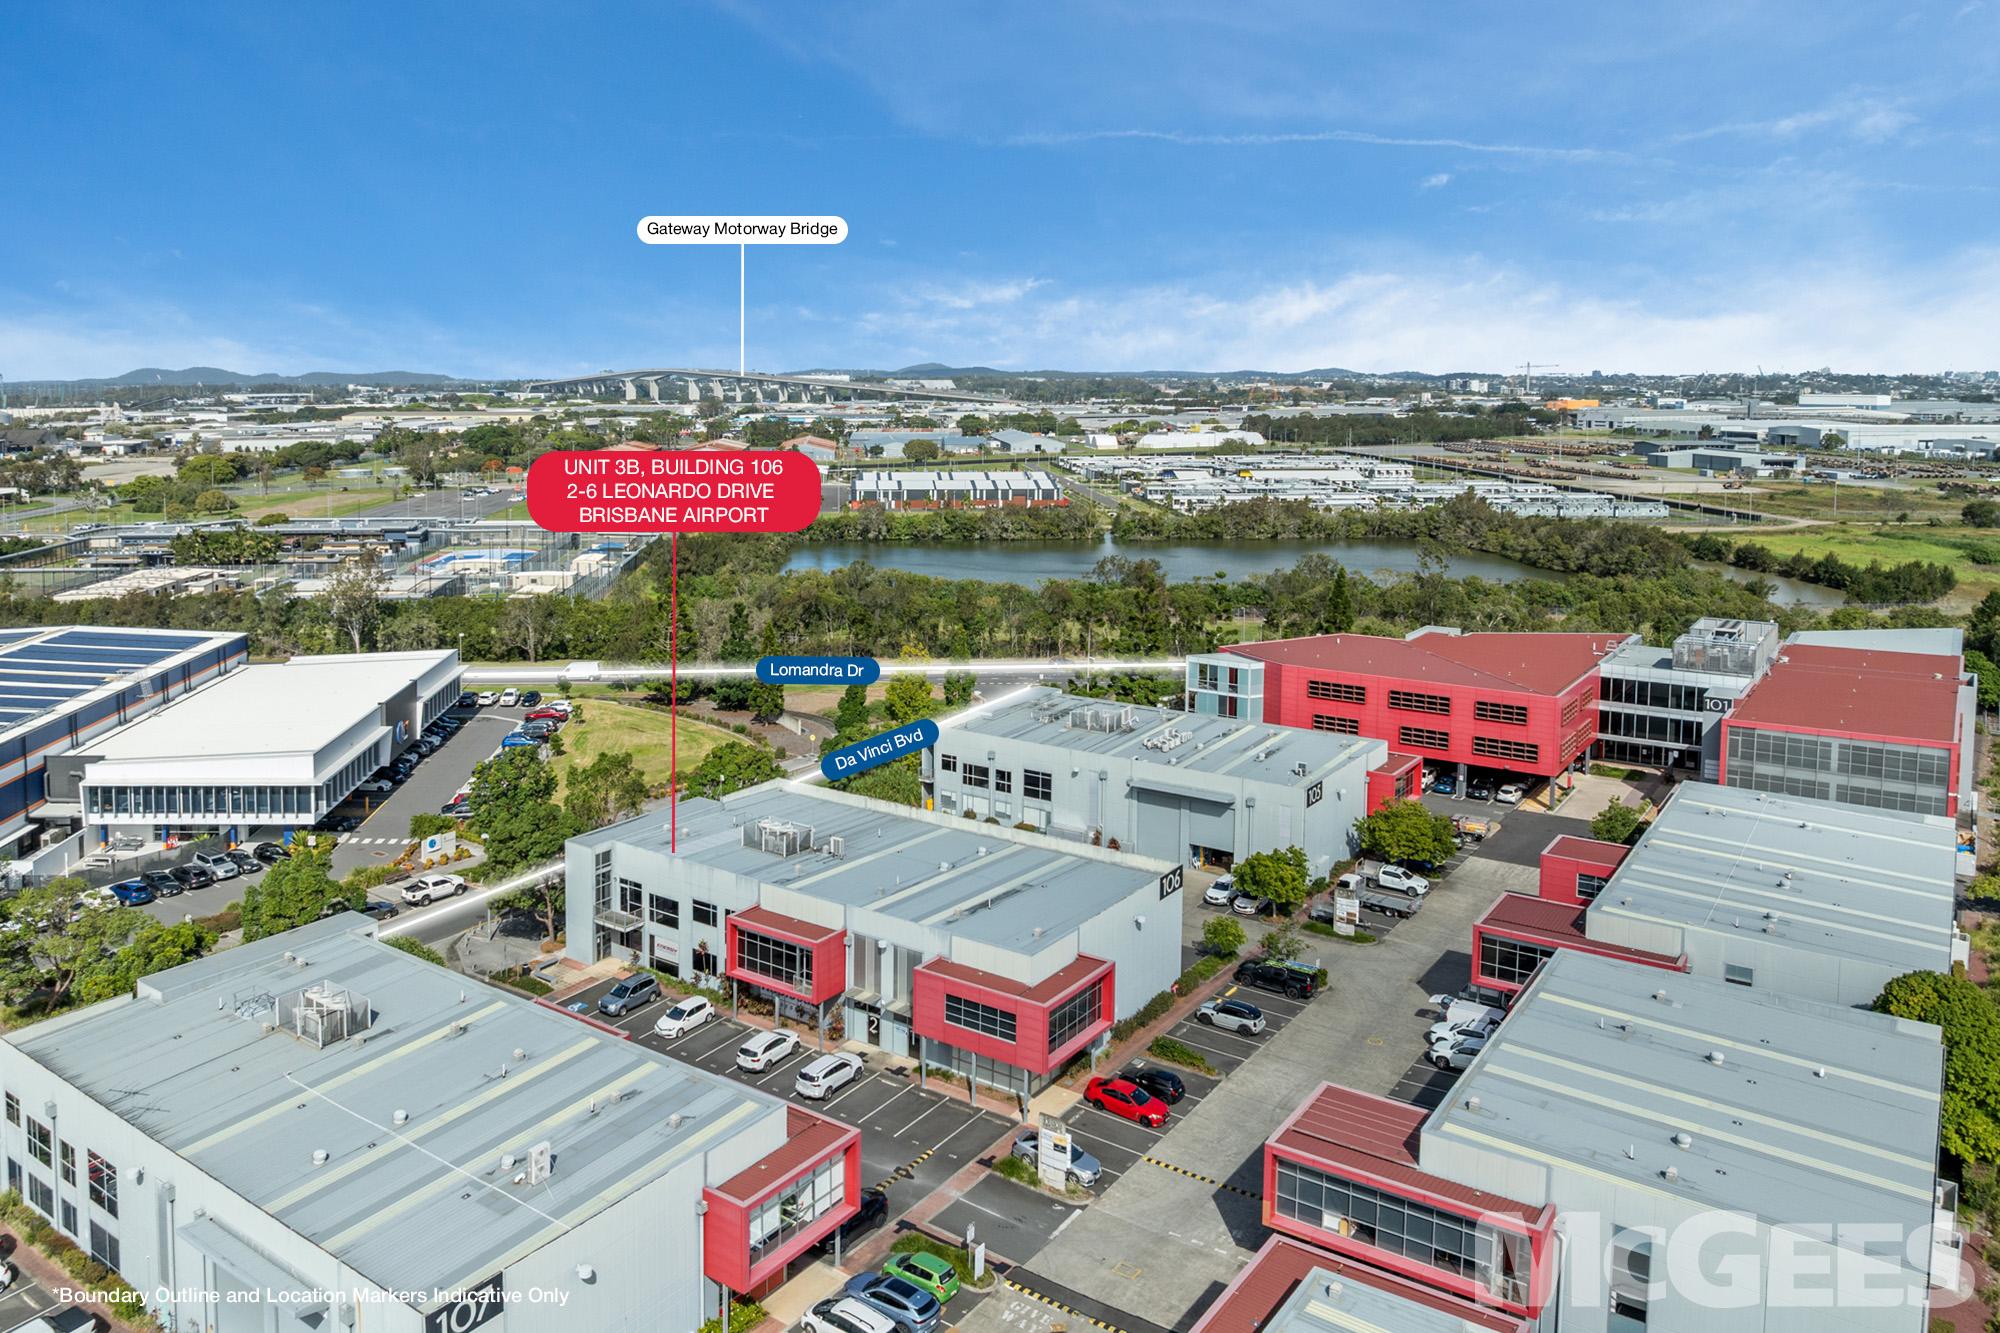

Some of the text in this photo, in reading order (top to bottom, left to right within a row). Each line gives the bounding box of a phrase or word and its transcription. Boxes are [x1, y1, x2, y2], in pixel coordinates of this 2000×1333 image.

[1705, 698, 1729, 711] 101
[1162, 869, 1181, 896] 106
[869, 1016, 878, 1034] 2
[435, 1284, 494, 1333] 107
